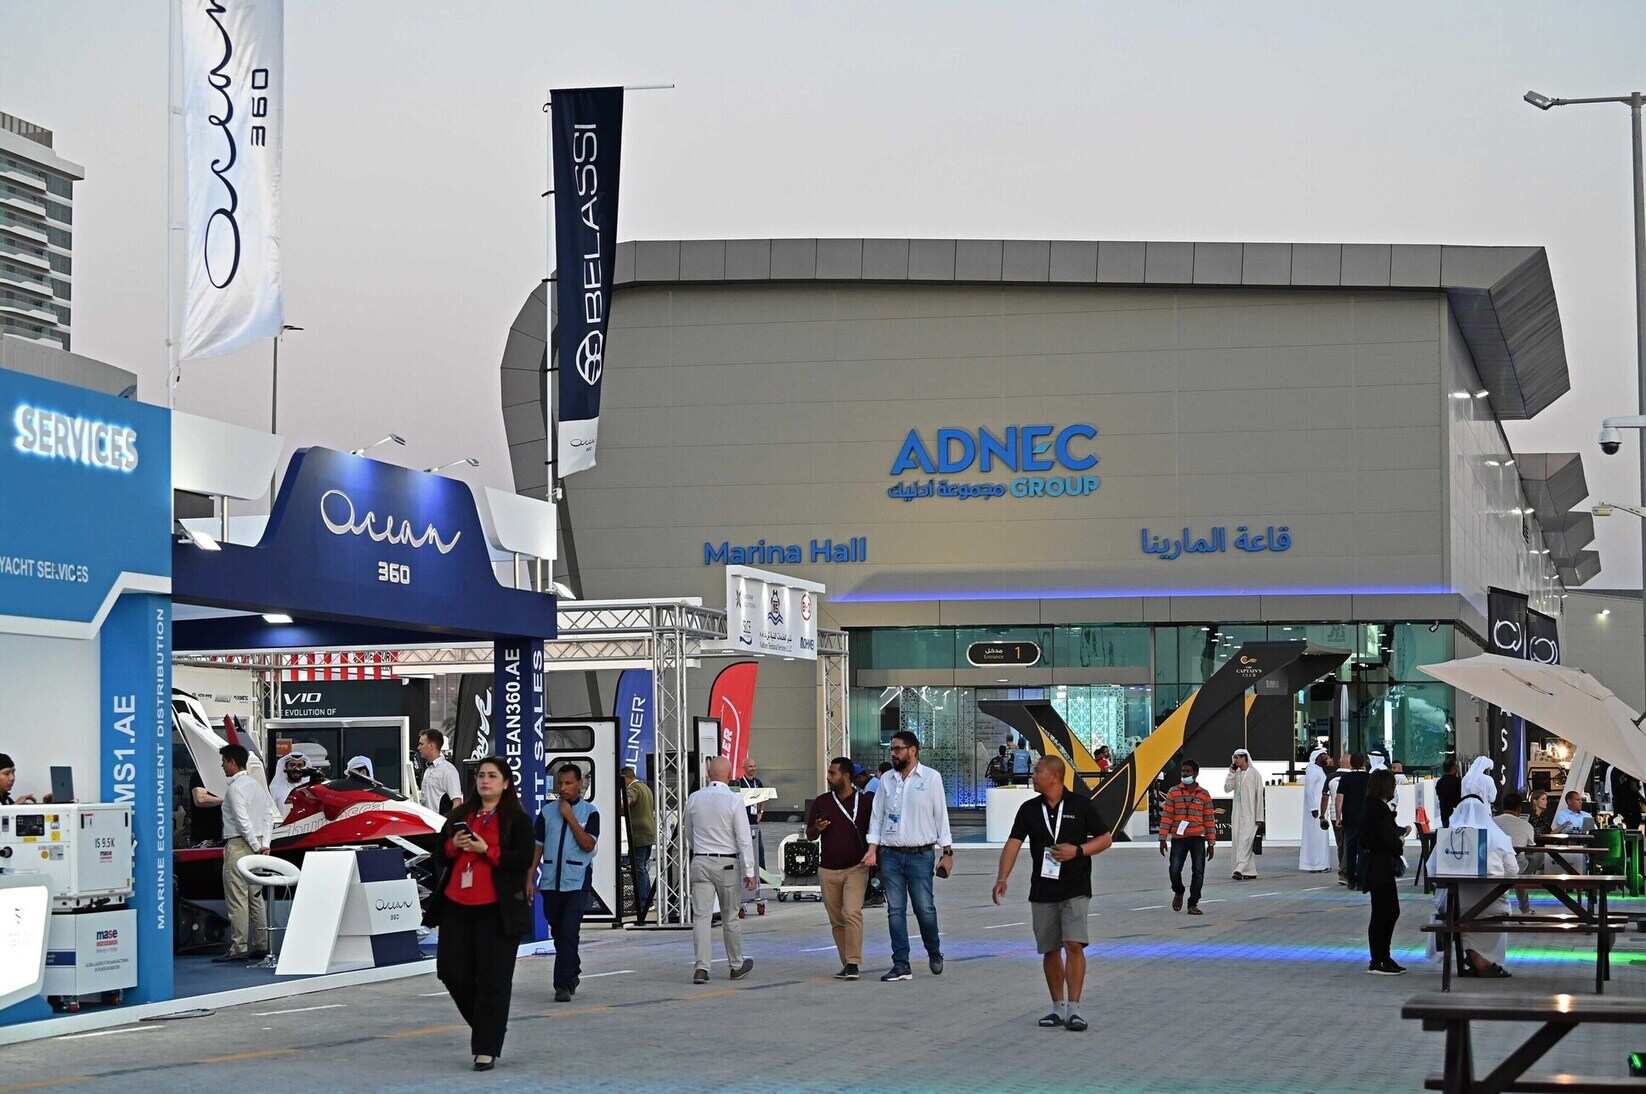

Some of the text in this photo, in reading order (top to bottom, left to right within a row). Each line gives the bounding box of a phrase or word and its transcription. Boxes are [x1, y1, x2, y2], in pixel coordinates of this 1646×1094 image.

[250, 68, 269, 147] 360
[205, 0, 240, 289] Ocea
[573, 123, 602, 325] BELASSI
[15, 404, 138, 472] SERVICES
[889, 423, 1100, 476] ADNEC
[936, 480, 1006, 501] مجموعة
[1010, 475, 1101, 498] GROUP
[320, 489, 461, 554] Ocean
[703, 537, 867, 565] Marina Hall
[1140, 525, 1292, 561] قاعة المارينا
[0, 555, 89, 583] YACHT SERVICES
[378, 560, 411, 585] 360
[1015, 646, 1021, 660] 1
[284, 709, 325, 717] EVOLUTION
[326, 708, 337, 716] OF
[532, 650, 544, 761] SALES
[722, 727, 733, 761] LER
[156, 608, 166, 930] MARINE EQUIPMENT DISTRIBUTION
[96, 929, 118, 940] mase
